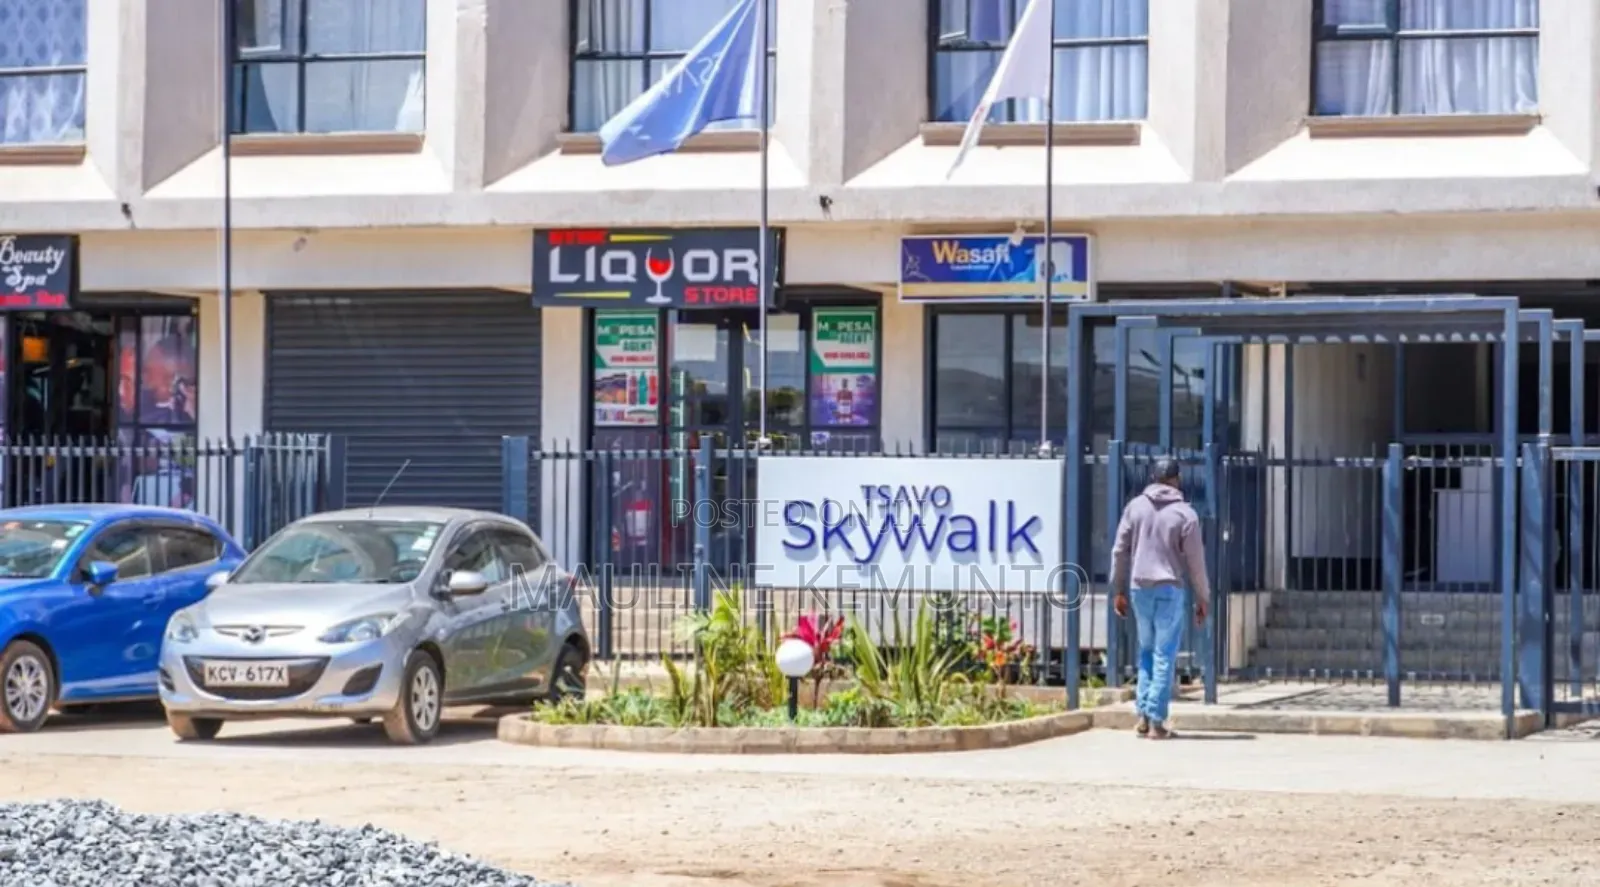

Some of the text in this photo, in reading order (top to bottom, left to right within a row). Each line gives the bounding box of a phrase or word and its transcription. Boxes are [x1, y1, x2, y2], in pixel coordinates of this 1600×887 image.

[0, 235, 64, 275] Beauty
[1, 265, 47, 293] Spa
[684, 287, 759, 303] STORE
[860, 484, 950, 510] TSAVO
[782, 498, 1042, 564] Skywalk
